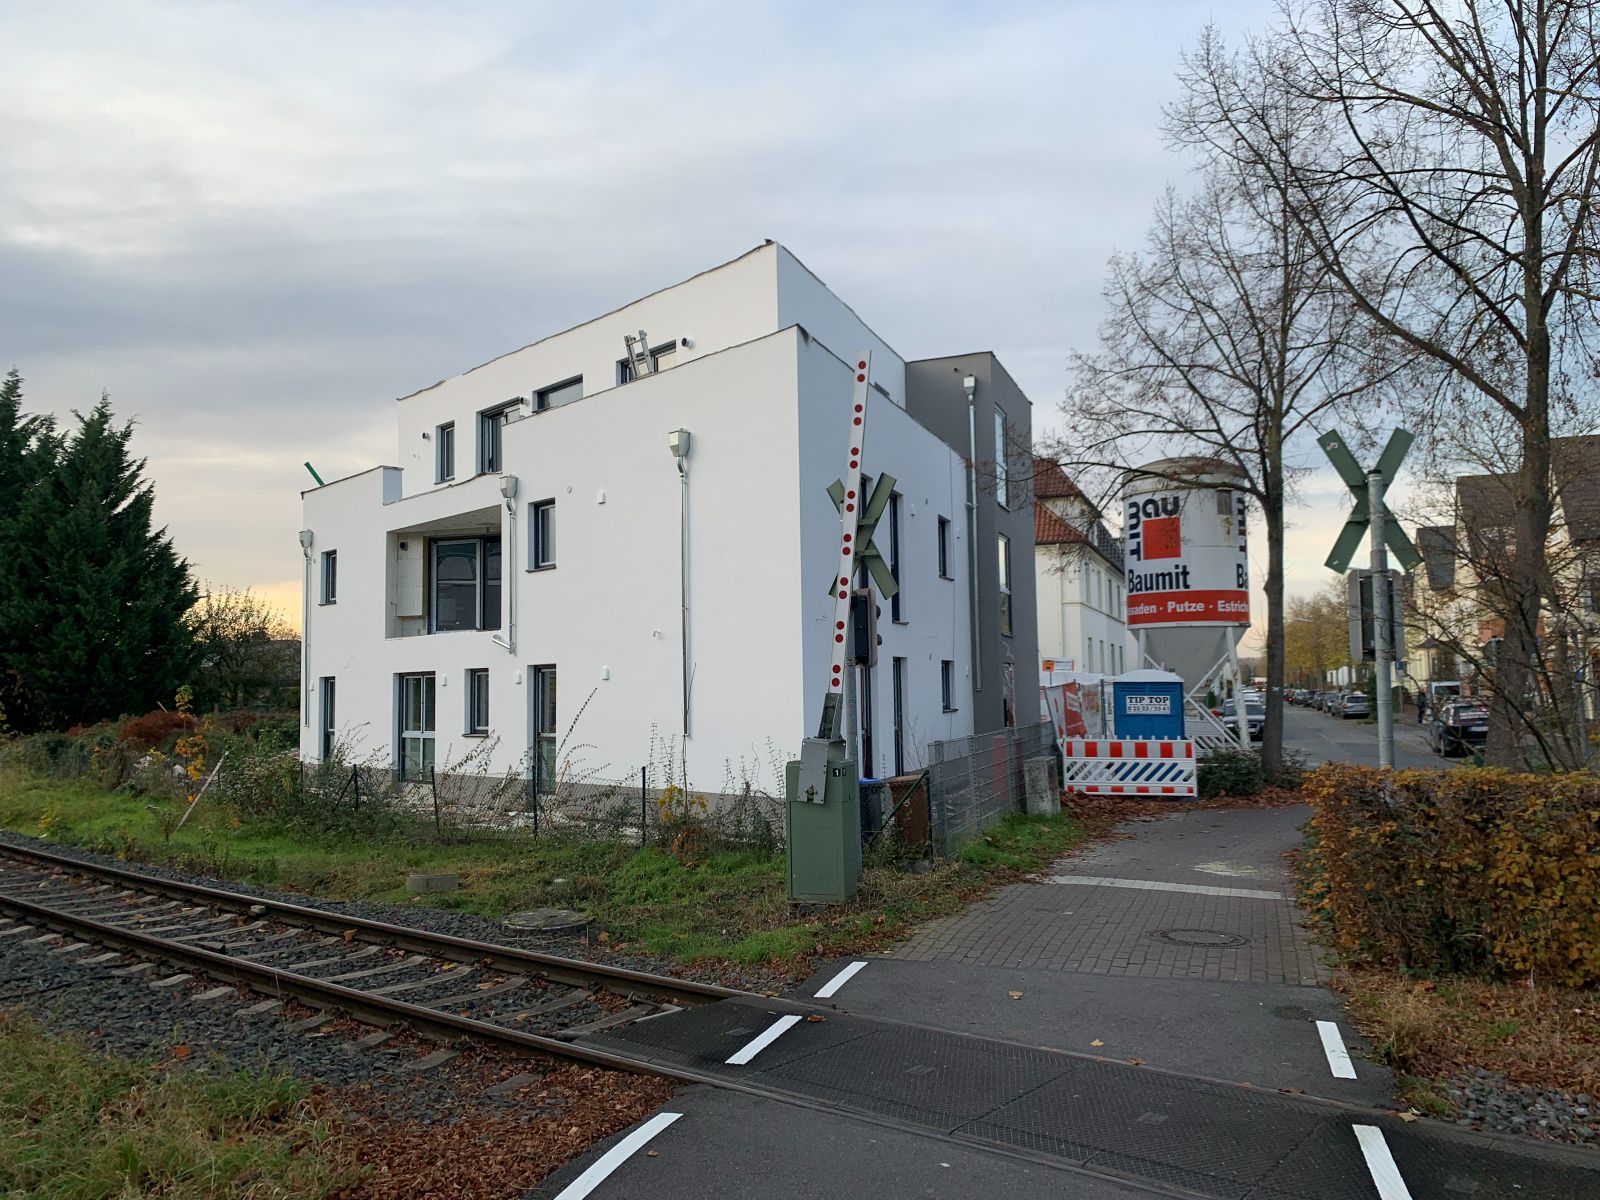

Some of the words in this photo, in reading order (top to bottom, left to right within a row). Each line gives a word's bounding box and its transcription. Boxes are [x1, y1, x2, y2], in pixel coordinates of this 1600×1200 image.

[1128, 564, 1190, 594] Baumit
[1167, 601, 1205, 613] Putze
[1127, 696, 1145, 704] TIP
[1148, 696, 1169, 704] TOP
